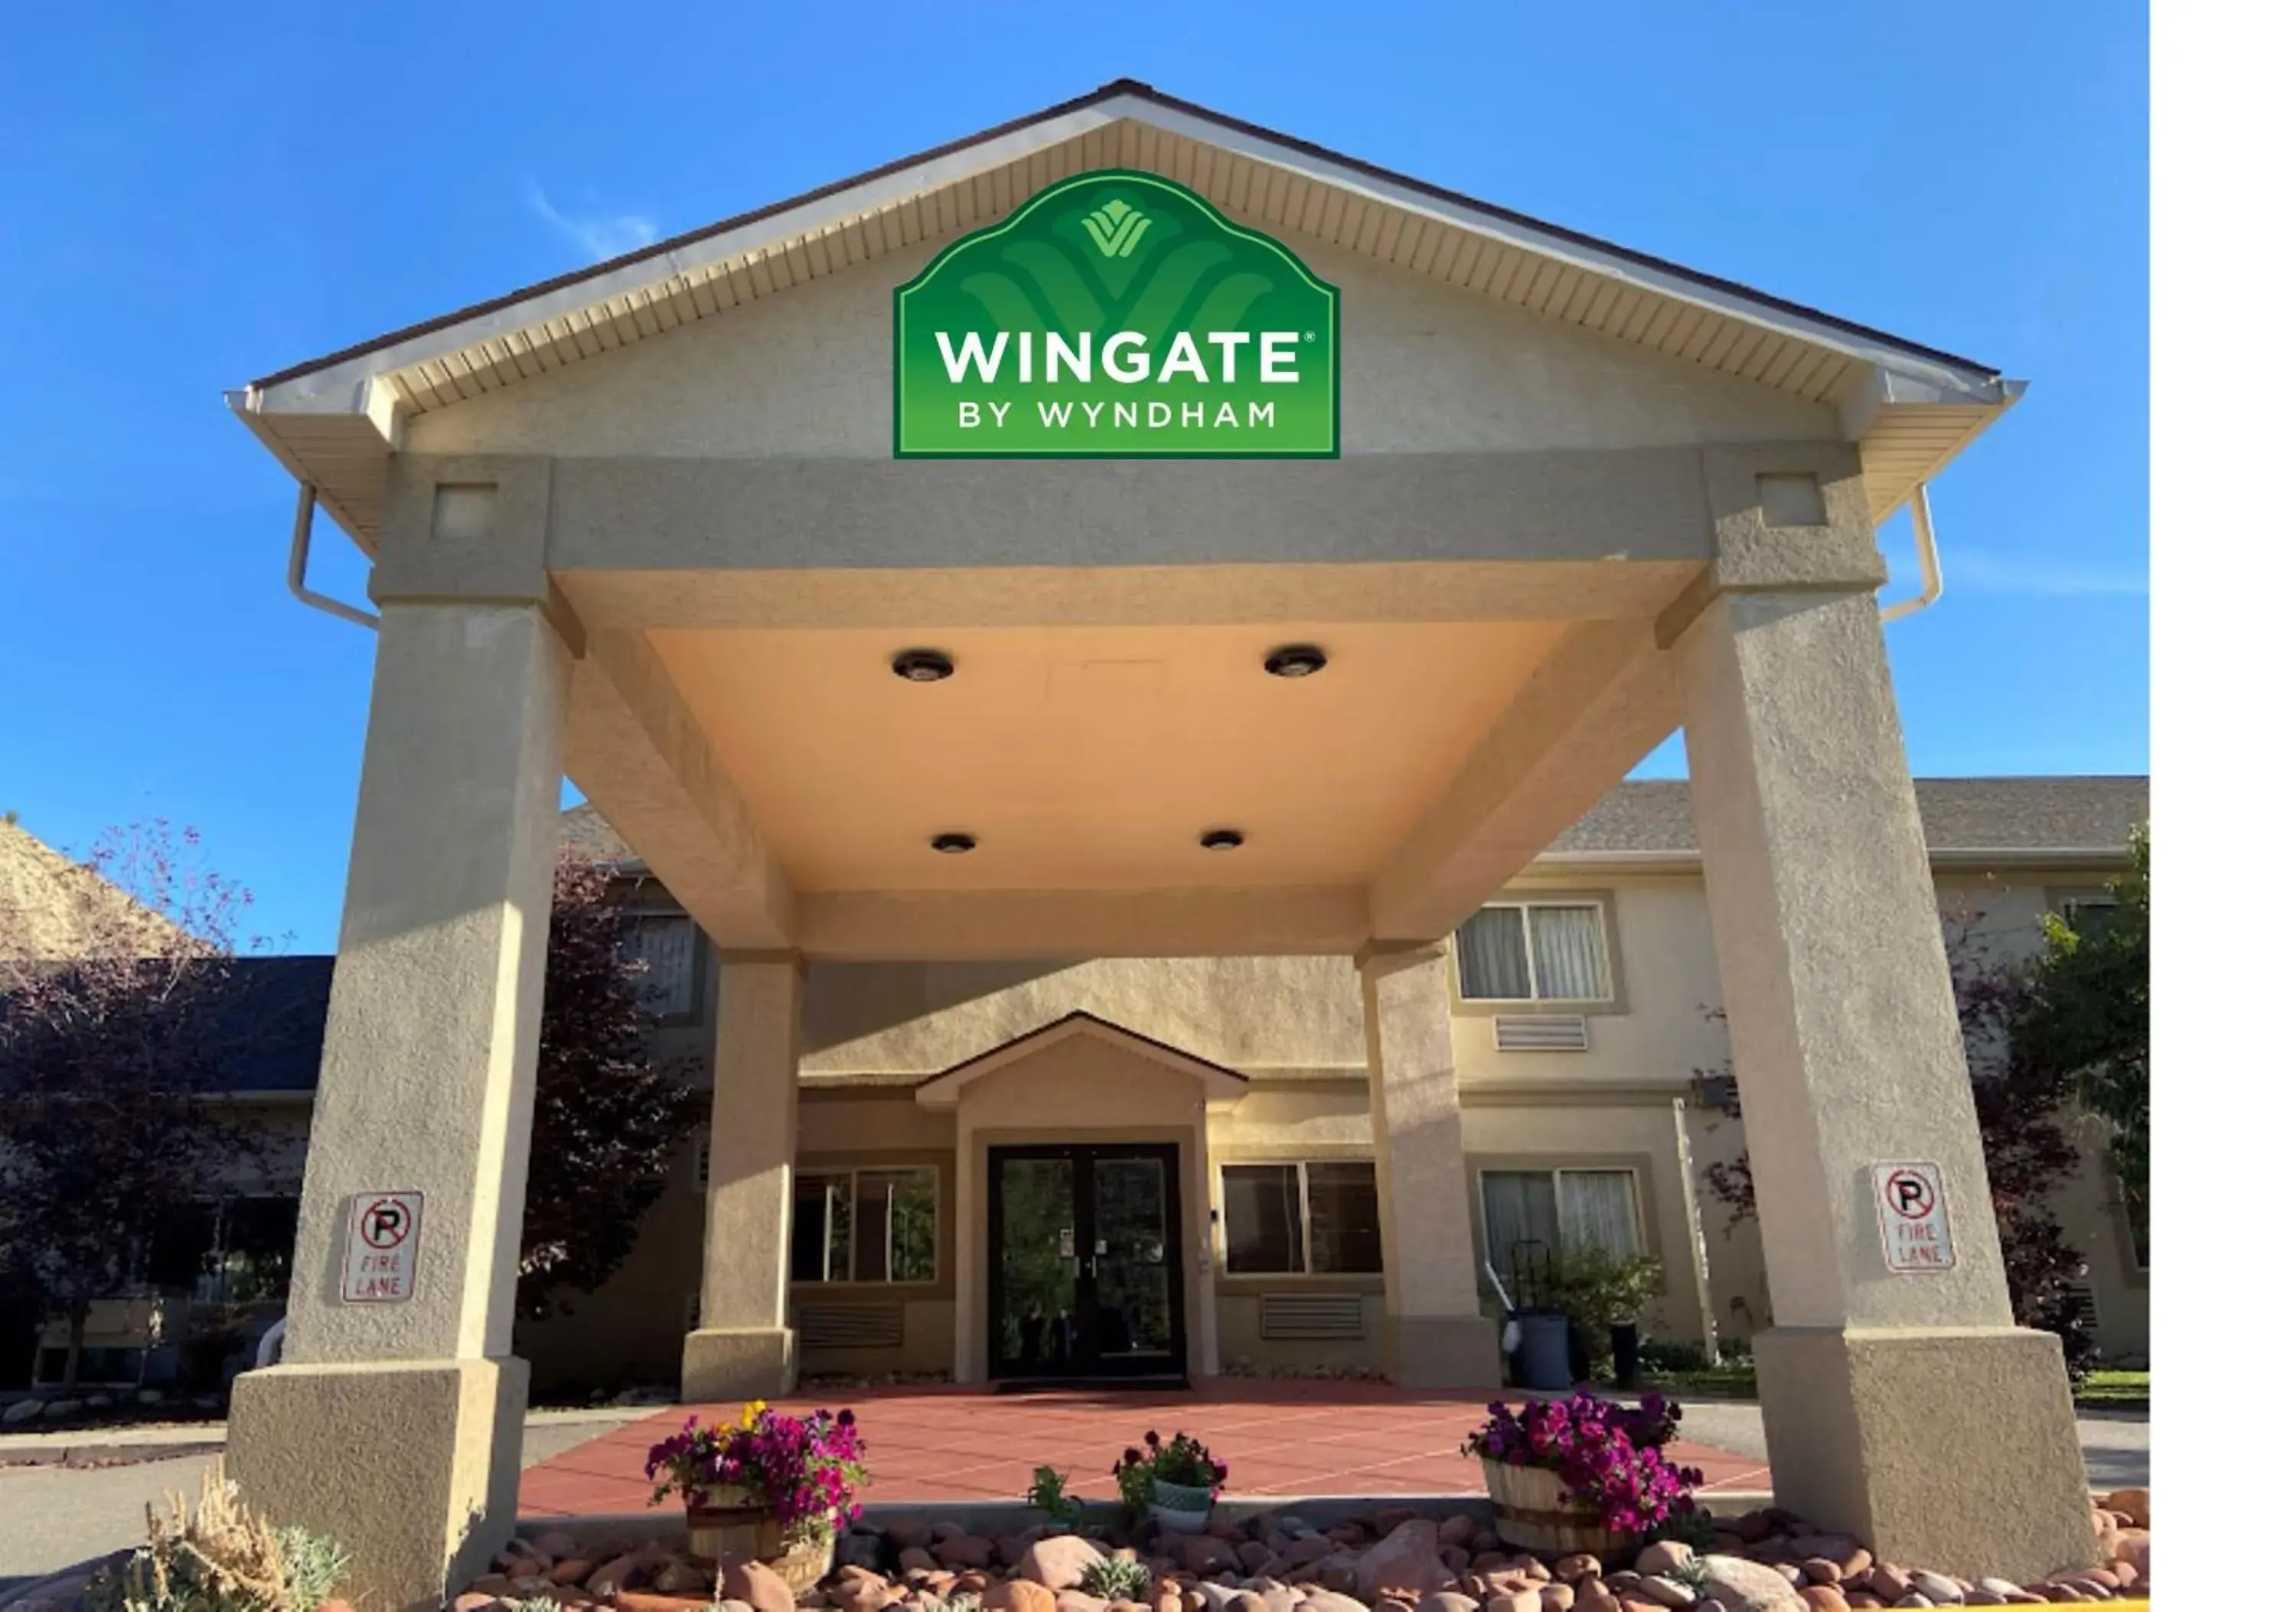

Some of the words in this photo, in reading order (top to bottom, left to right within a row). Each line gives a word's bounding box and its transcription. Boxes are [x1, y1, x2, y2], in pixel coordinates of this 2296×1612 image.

[934, 331, 1300, 383] WINGATE
[958, 402, 1012, 428] BY
[1037, 402, 1275, 428] WYNDHAM
[1896, 1223, 1938, 1241] FIRE
[1898, 1246, 1942, 1262] LANE
[360, 1255, 400, 1273] FIRE
[356, 1277, 400, 1295] LANE
